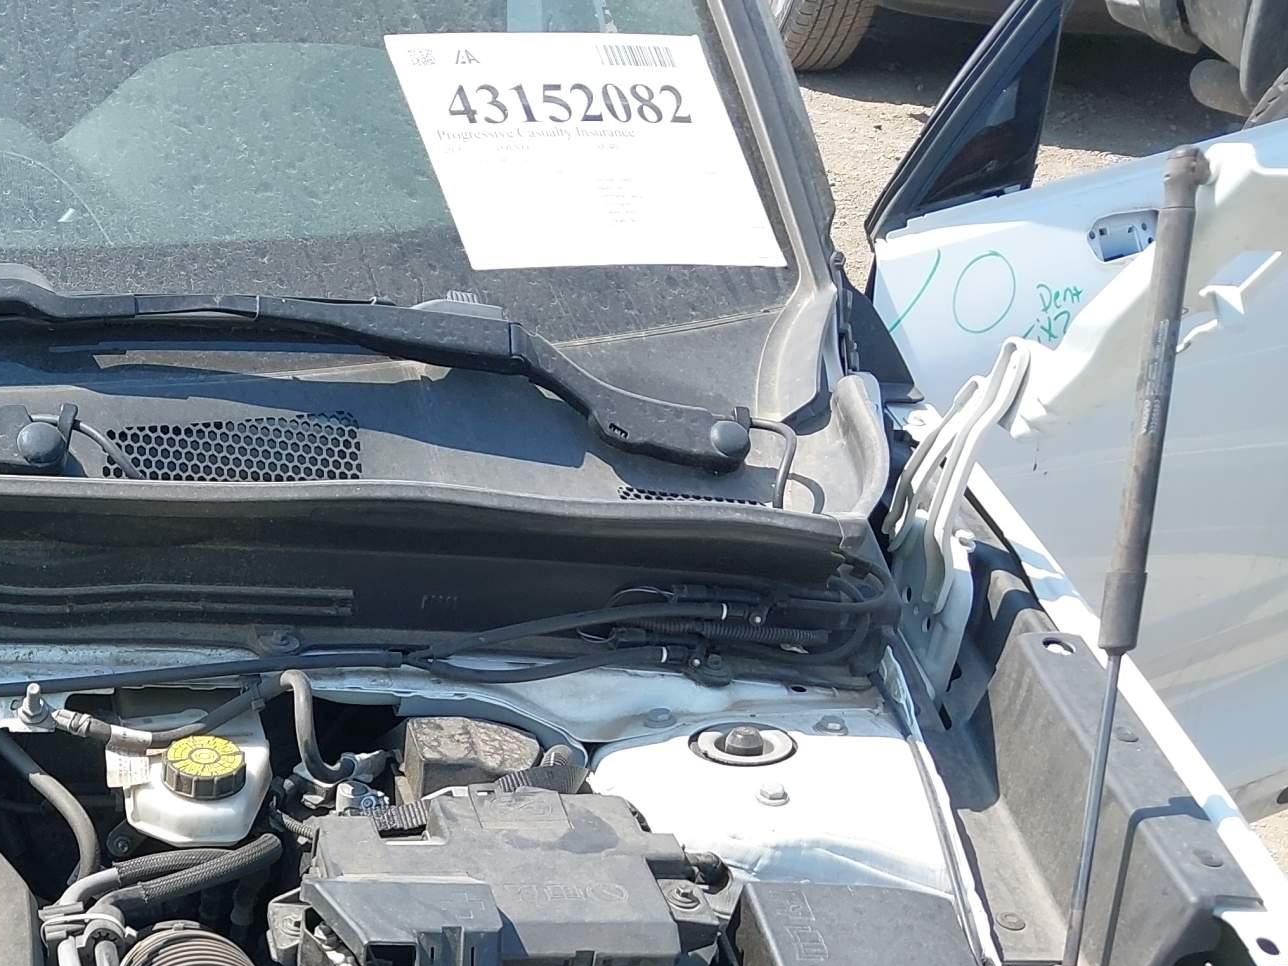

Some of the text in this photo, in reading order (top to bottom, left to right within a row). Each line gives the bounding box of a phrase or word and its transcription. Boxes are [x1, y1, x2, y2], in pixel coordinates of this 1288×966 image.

[449, 84, 692, 124] 43152082
[437, 128, 514, 142] Progressive
[576, 127, 635, 139] Insurance
